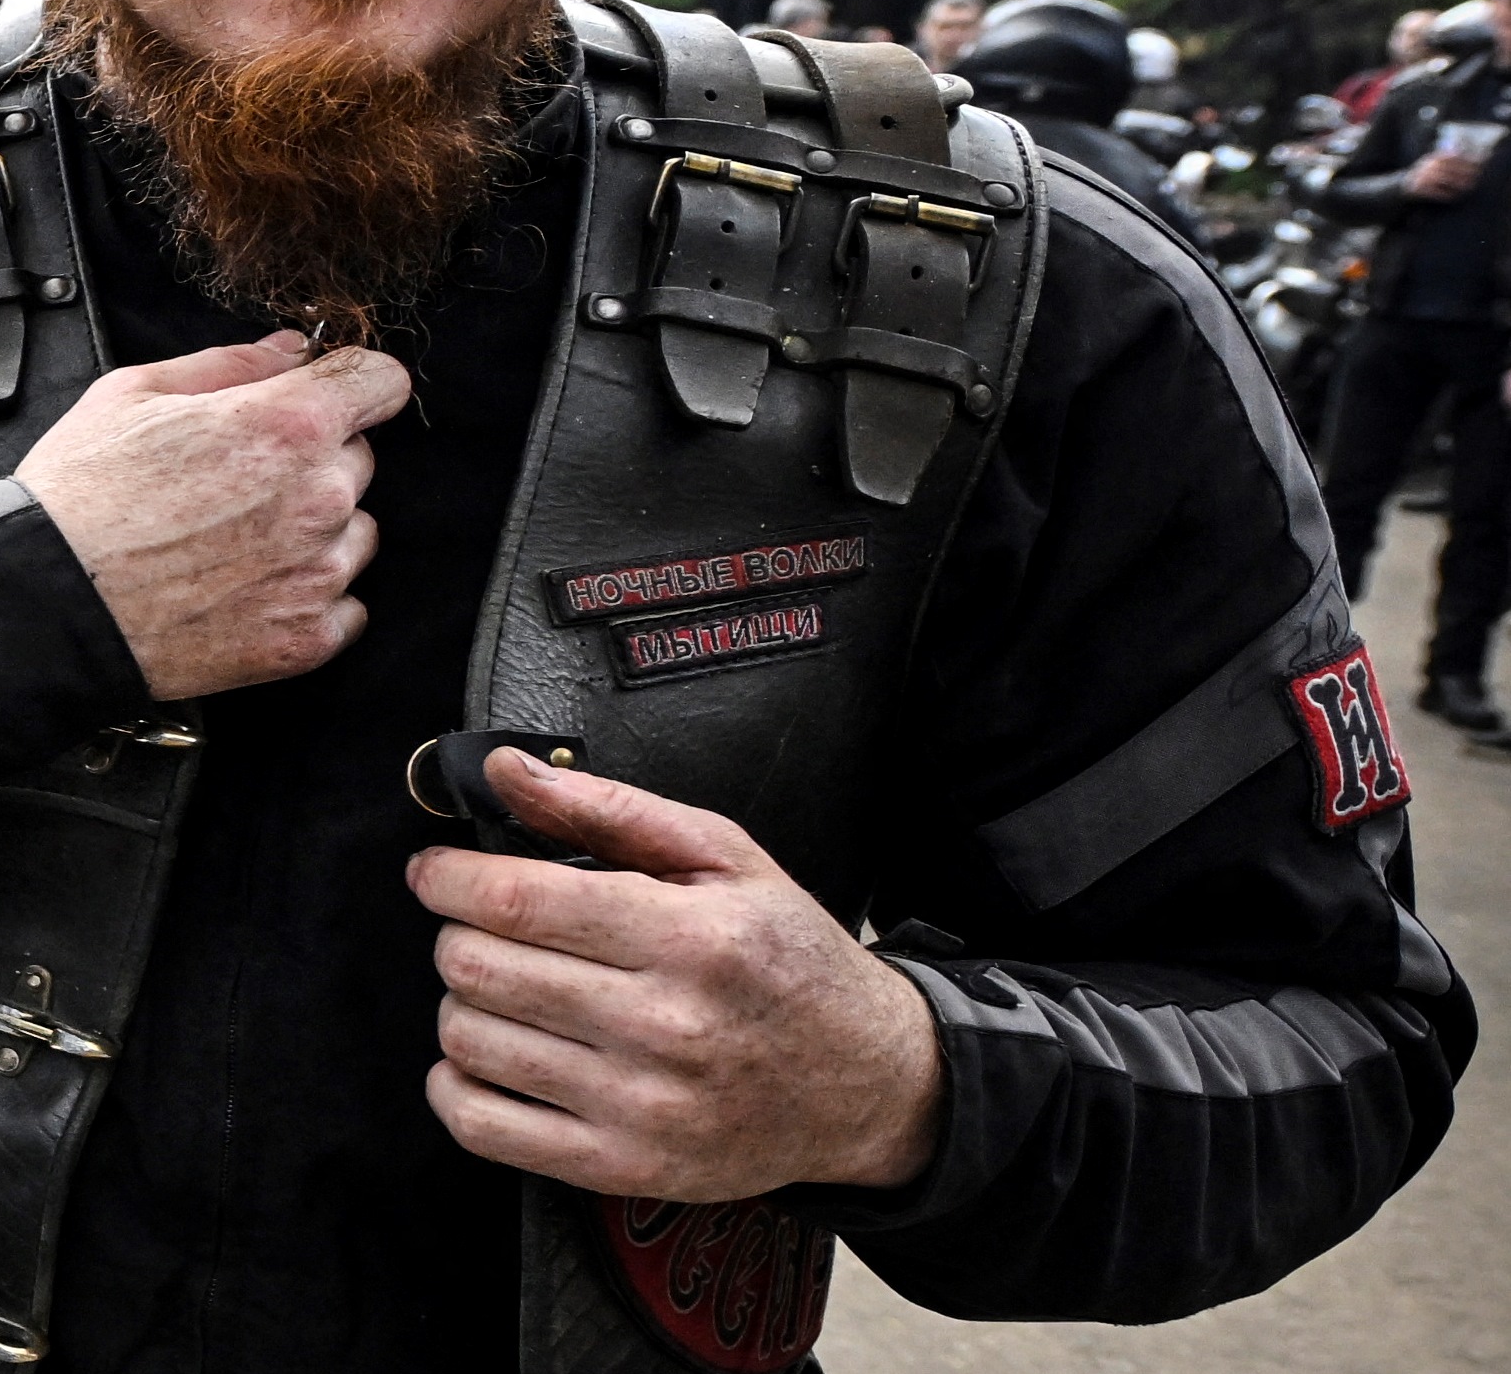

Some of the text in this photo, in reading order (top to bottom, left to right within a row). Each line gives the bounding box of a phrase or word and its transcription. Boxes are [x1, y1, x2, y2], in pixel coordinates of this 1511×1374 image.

[567, 536, 865, 612] НОЧНЫЕ ВОЛКИ
[631, 603, 823, 669] МЫТИЩИ
